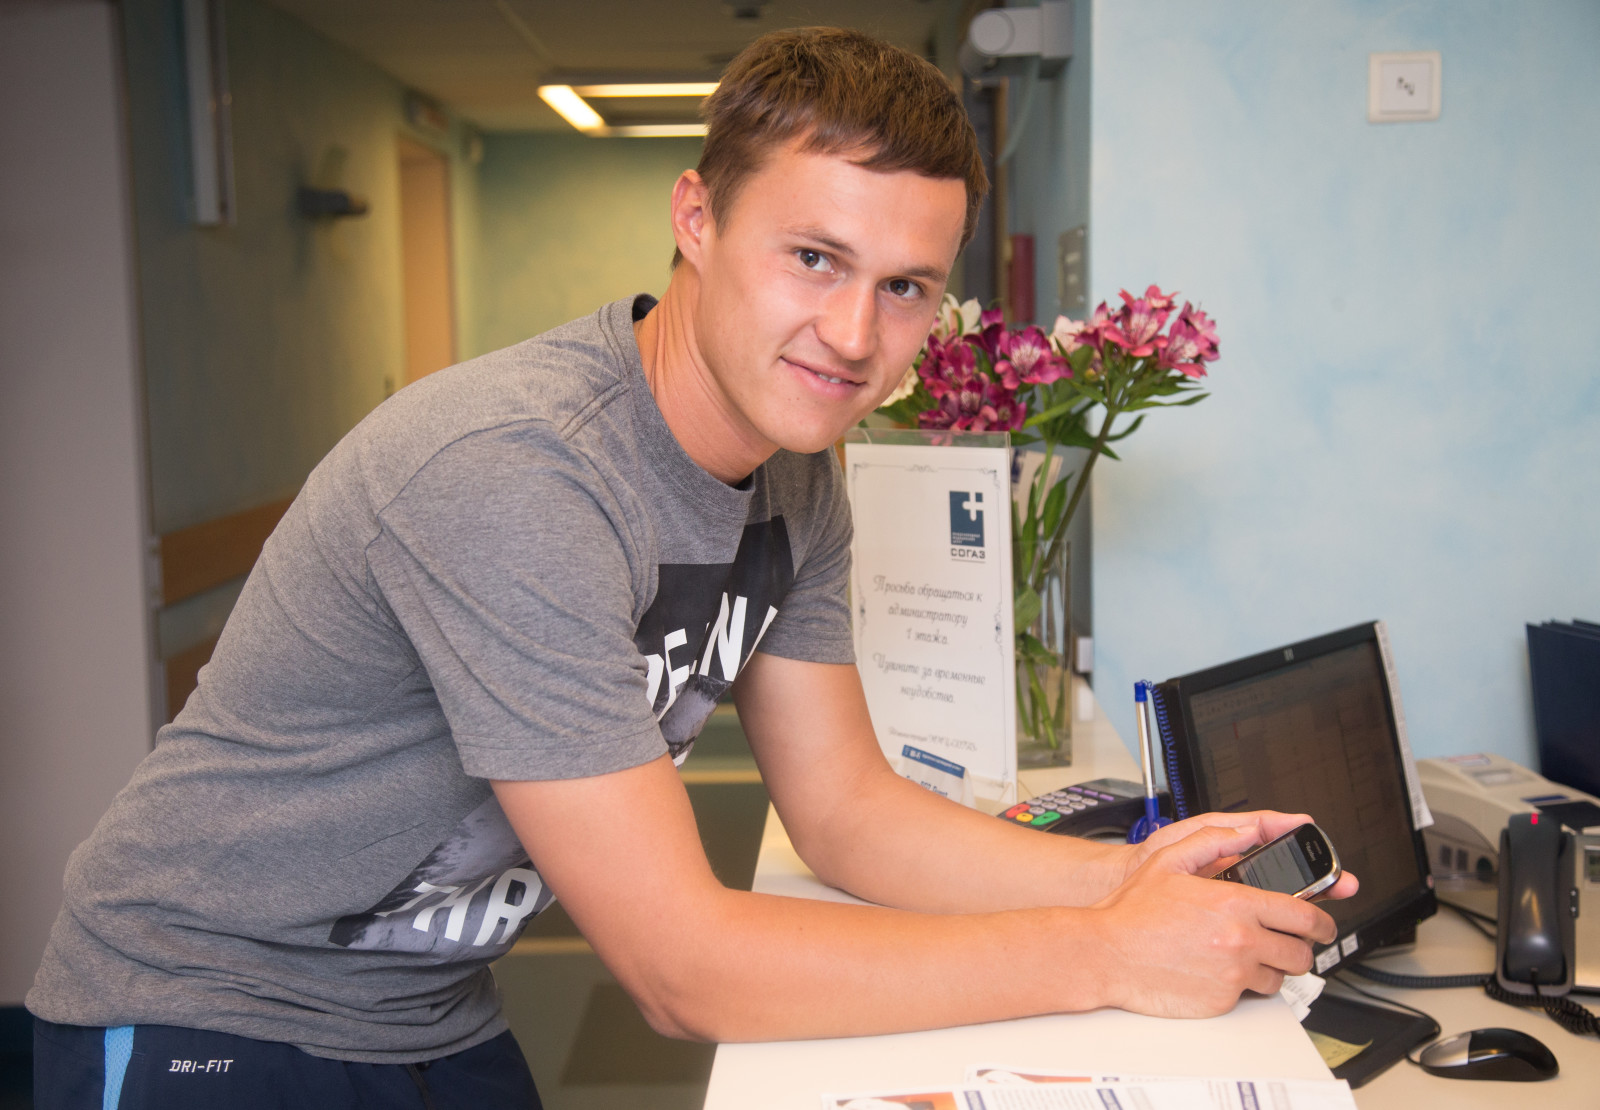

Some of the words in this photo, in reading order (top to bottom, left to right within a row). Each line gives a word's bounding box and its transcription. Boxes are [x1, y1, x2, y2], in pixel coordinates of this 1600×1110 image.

[951, 548, 986, 559] СОГАЗ
[873, 574, 916, 594] Просьба
[917, 581, 974, 602] обращаться
[976, 592, 983, 602] к
[888, 603, 969, 627] администратору
[872, 652, 920, 673] Извините
[935, 666, 986, 686] временные
[169, 1060, 234, 1073] DRI-FIT
